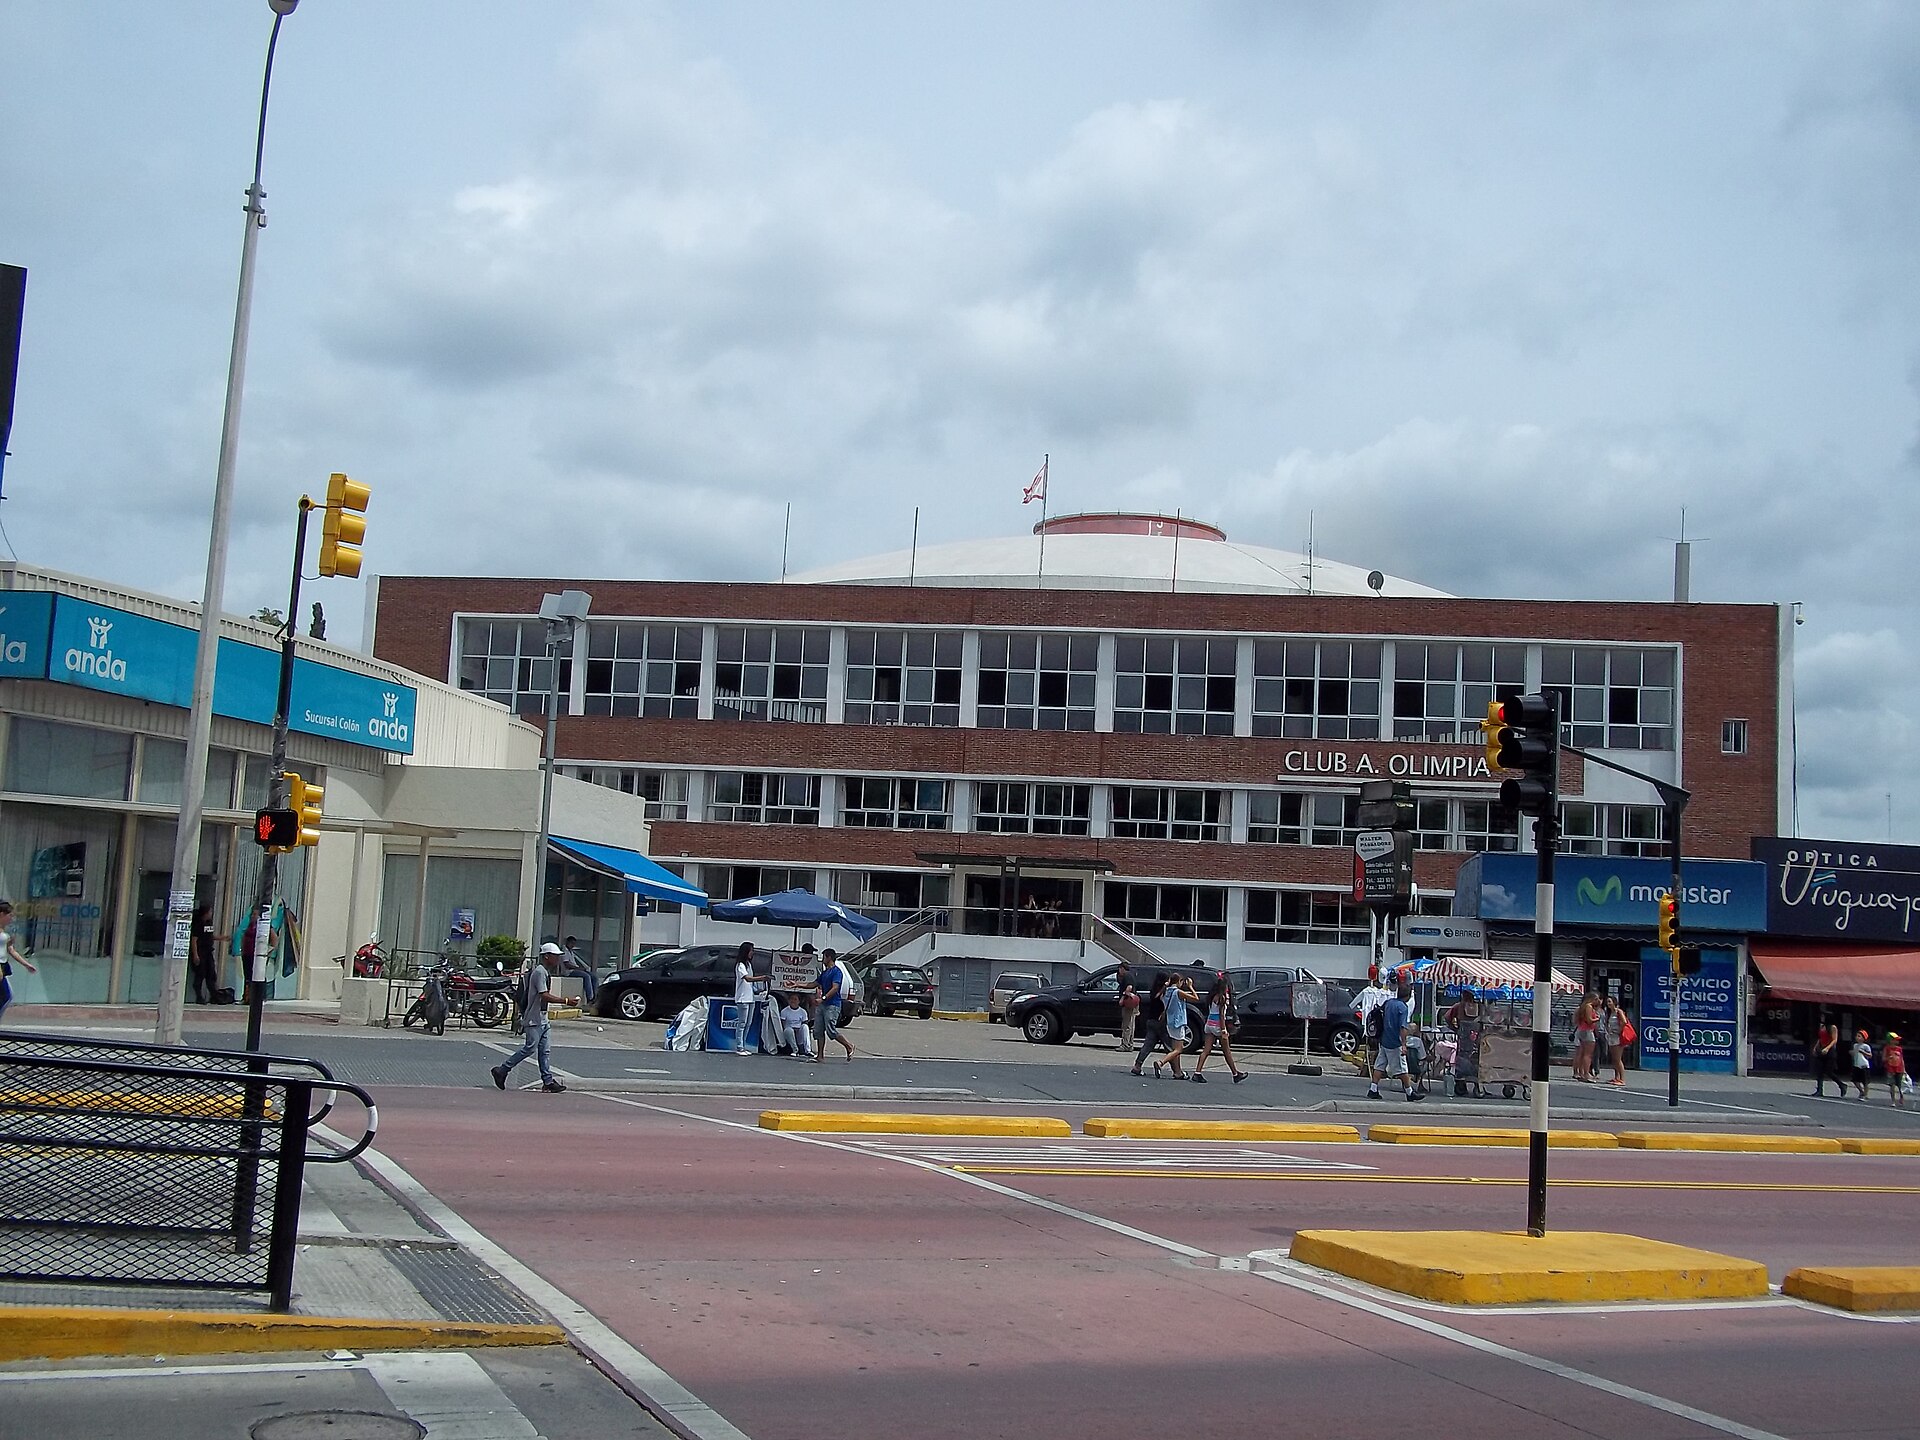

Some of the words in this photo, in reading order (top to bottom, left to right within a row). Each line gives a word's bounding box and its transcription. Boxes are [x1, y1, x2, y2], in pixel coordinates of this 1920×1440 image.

[65, 648, 127, 682] anda
[304, 709, 338, 728] Sucursal
[339, 717, 360, 732] Colón
[368, 717, 408, 743] anda
[1284, 750, 1347, 773] CLUB
[1355, 753, 1380, 774] A.
[1388, 754, 1492, 777] OLIMPIA
[1787, 850, 1878, 867] OPTICA
[1454, 929, 1481, 938] BANRED
[1660, 990, 1729, 1003] TCNICO
[1767, 1009, 1791, 1020] 950
[1684, 1048, 1732, 1056] GARANTIDOS
[1766, 1052, 1806, 1062] CONTACTO
